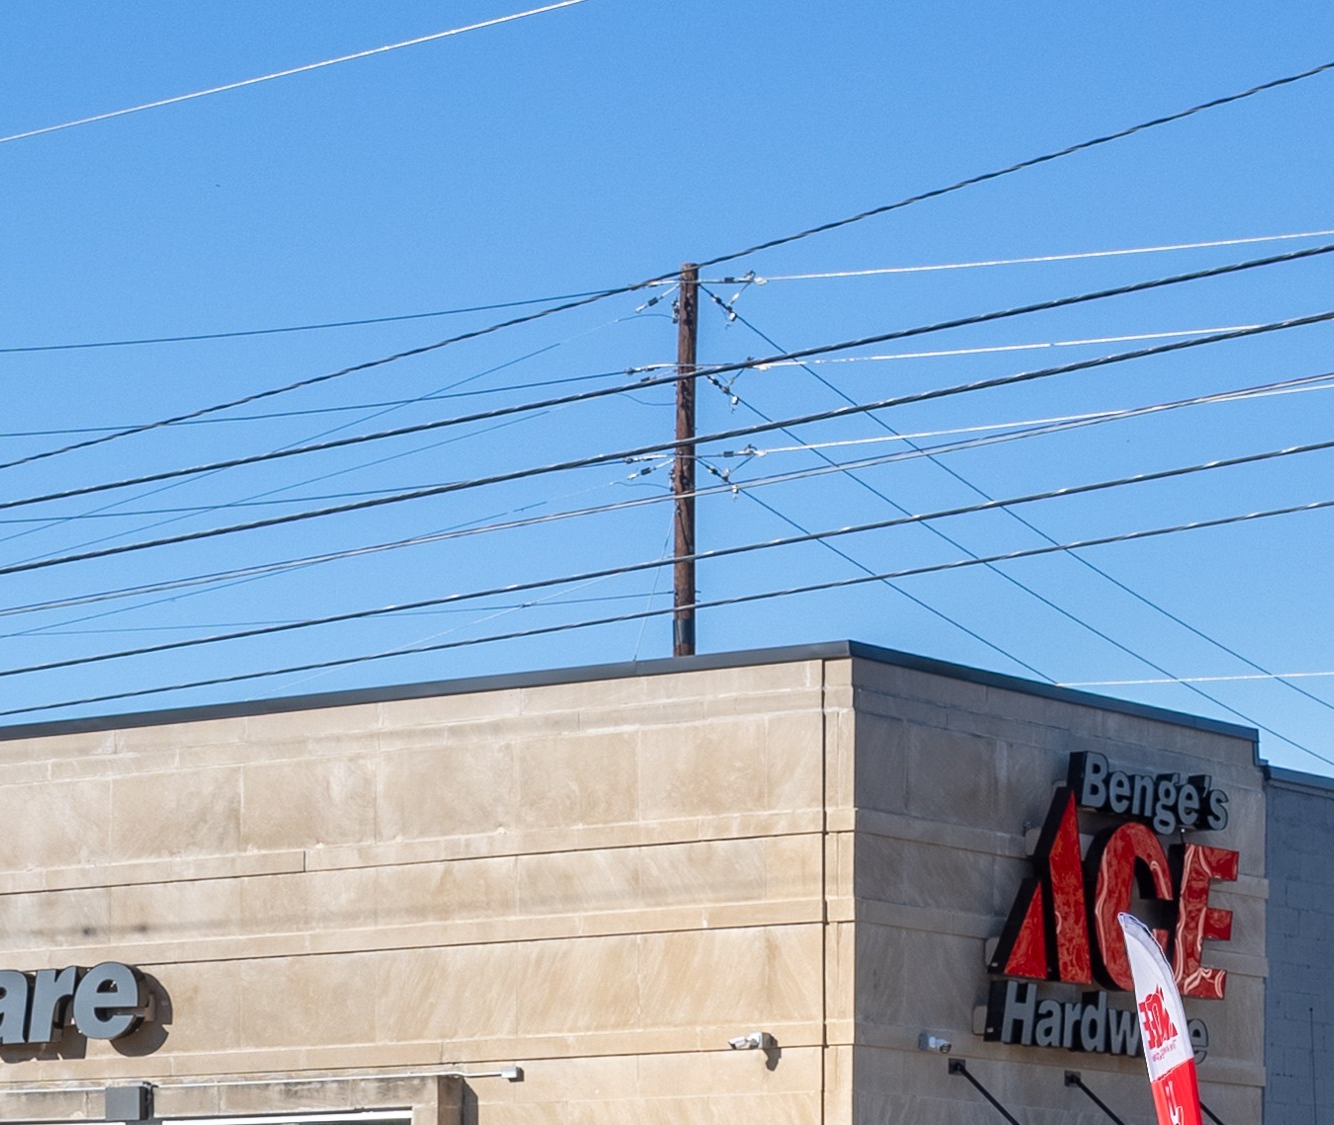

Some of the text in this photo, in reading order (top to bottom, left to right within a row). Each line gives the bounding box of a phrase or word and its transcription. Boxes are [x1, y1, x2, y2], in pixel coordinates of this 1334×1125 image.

[1081, 751, 1229, 835] Benge's
[1004, 791, 1239, 1000] ACE
[1001, 980, 1208, 1064] Hardwe
